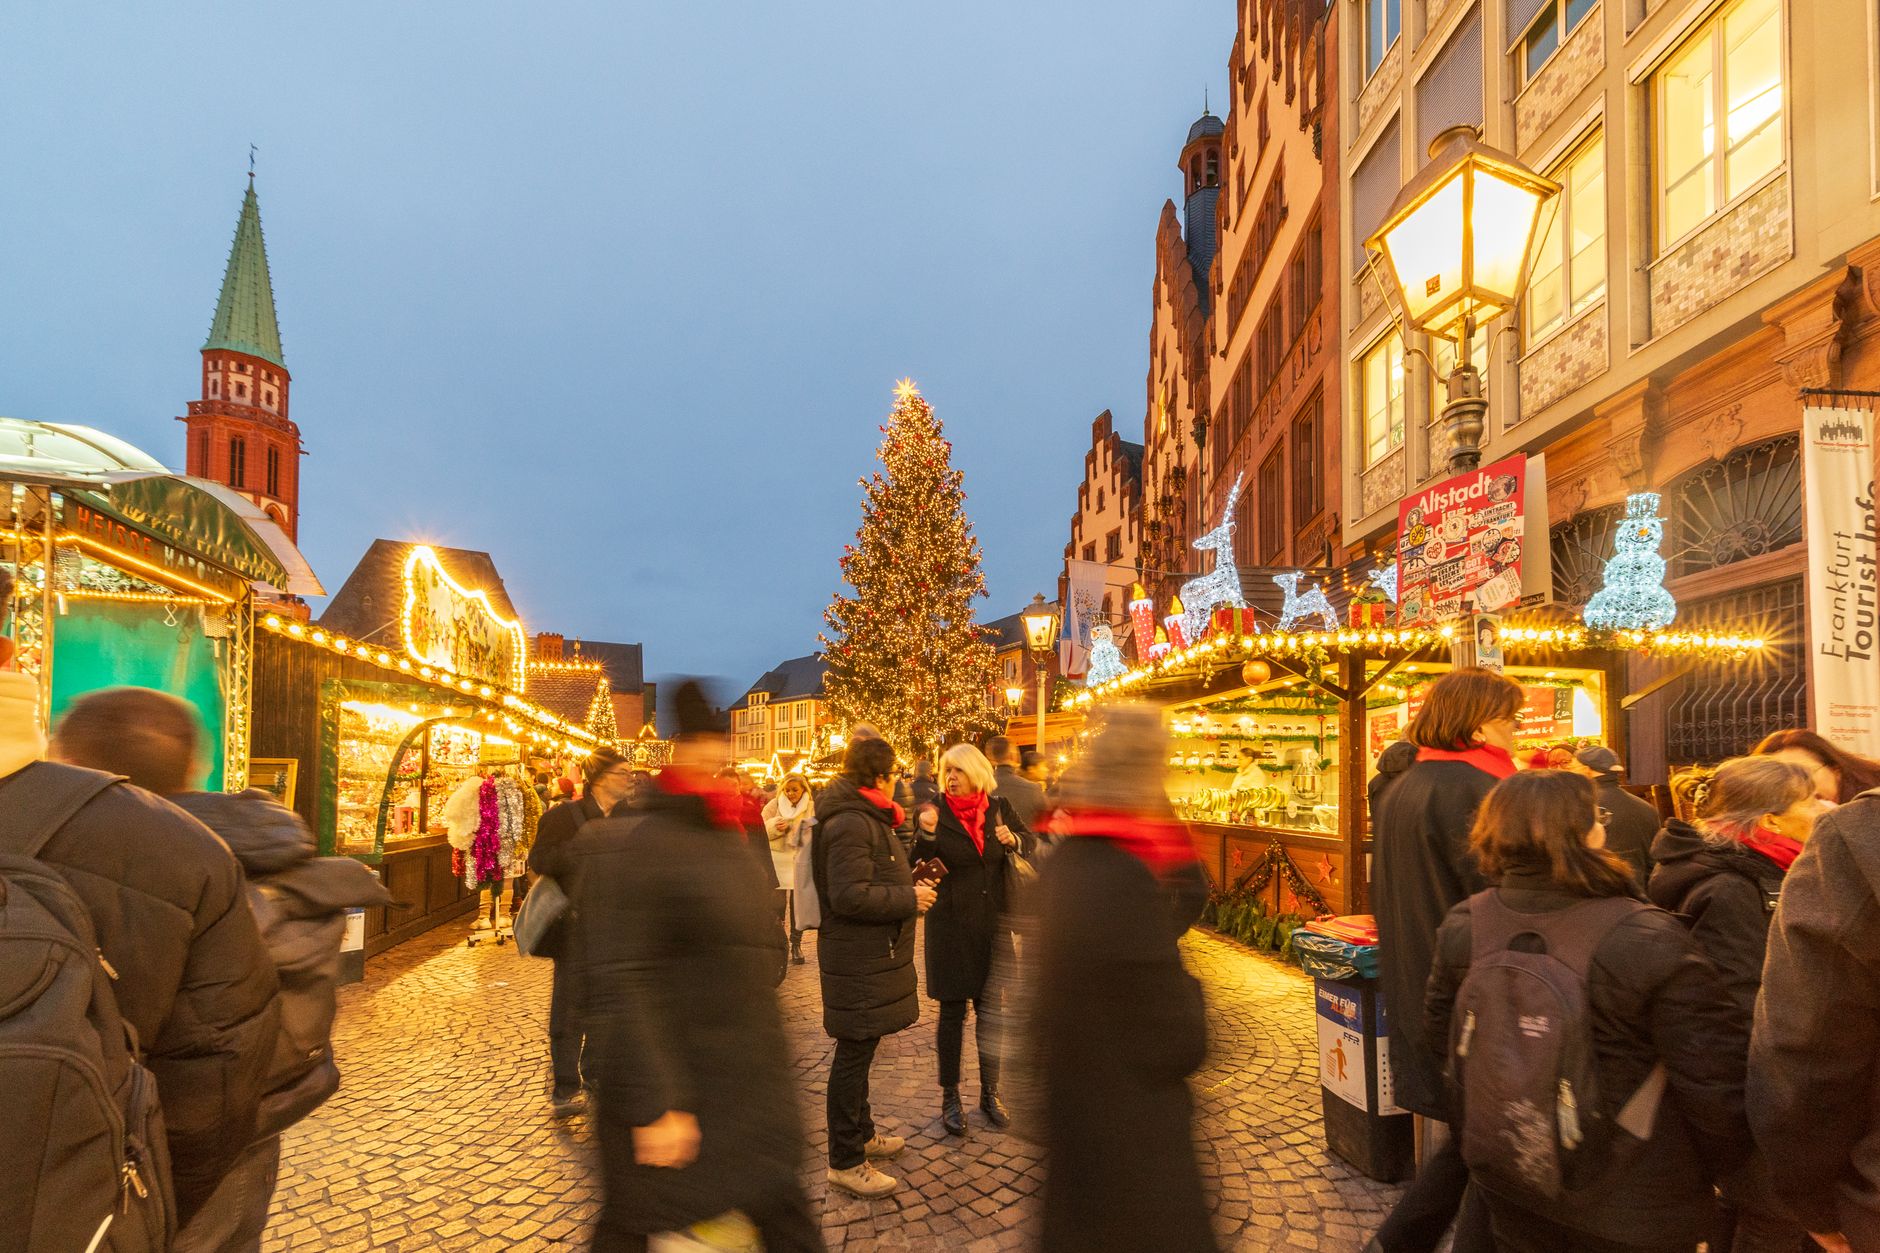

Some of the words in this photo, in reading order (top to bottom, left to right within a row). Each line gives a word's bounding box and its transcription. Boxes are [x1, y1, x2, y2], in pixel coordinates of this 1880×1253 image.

[1419, 472, 1493, 515] Altstadt
[77, 505, 153, 559] HEISSE
[1821, 531, 1852, 659] Frankfurt
[1845, 553, 1877, 662] Tourist
[1479, 660, 1502, 672] Goethe
